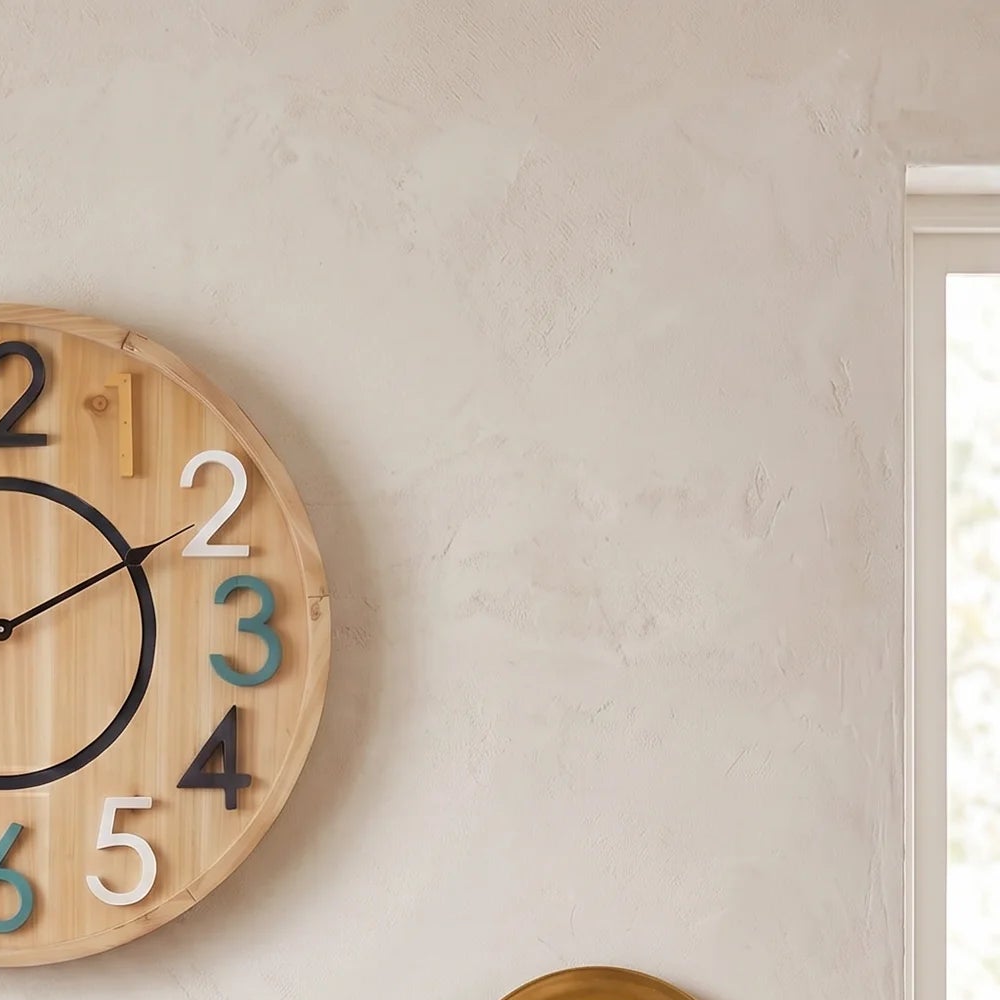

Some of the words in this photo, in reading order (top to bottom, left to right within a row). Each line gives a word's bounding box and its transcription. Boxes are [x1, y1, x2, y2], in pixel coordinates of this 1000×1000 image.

[105, 372, 134, 478] 1
[179, 450, 251, 557] 2
[209, 575, 284, 687] 3
[176, 704, 252, 811] 4
[86, 796, 158, 906] 5
